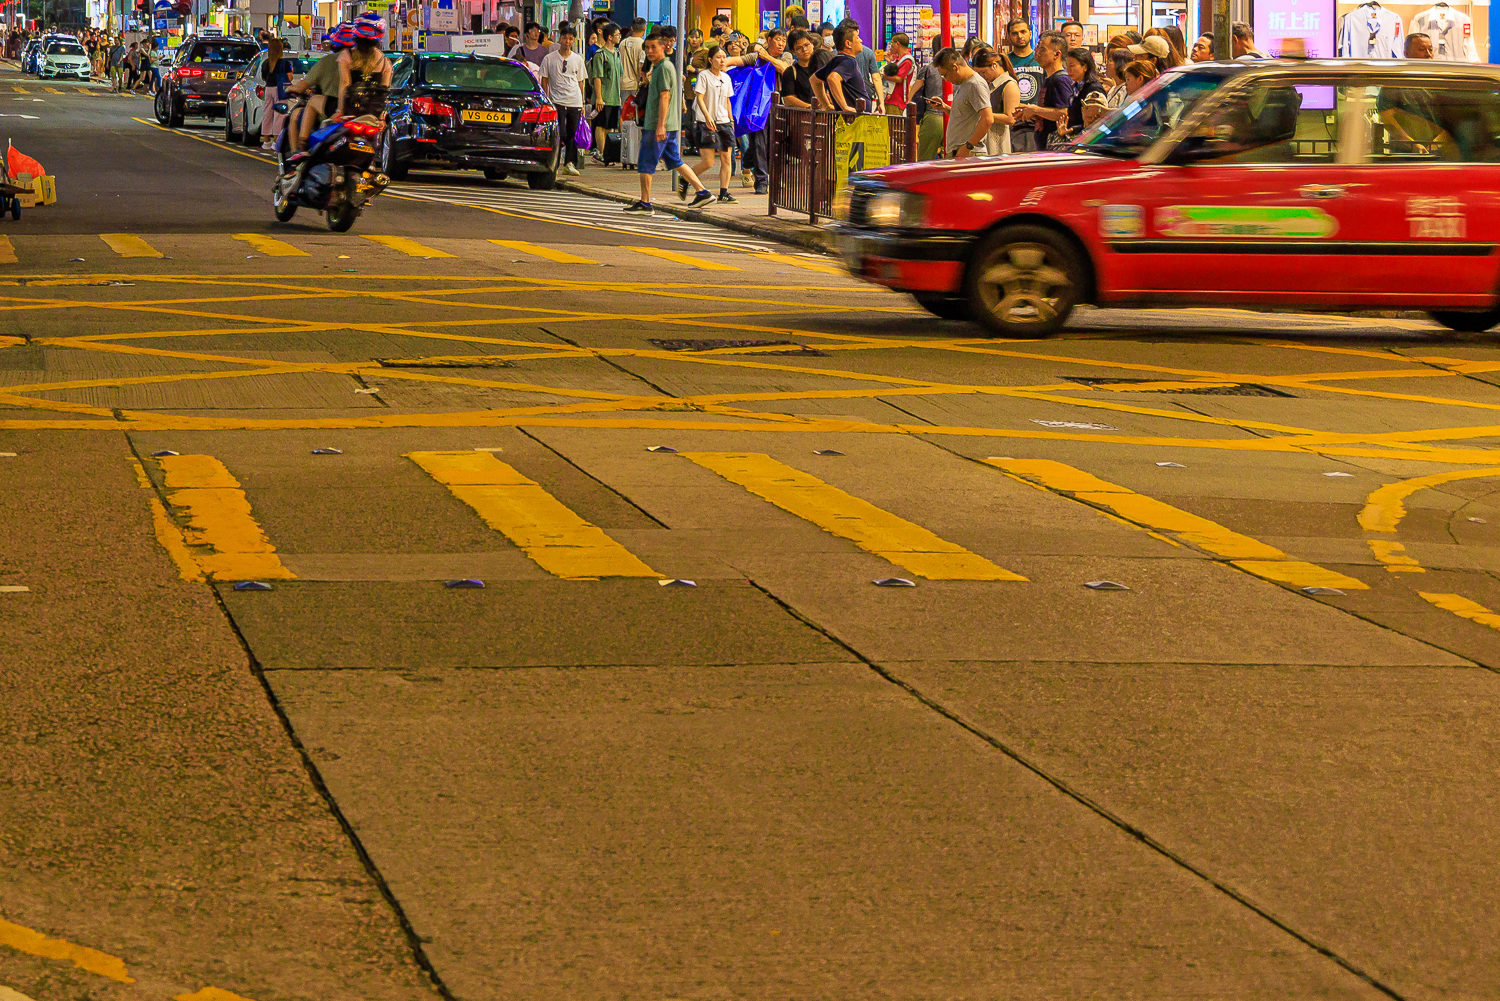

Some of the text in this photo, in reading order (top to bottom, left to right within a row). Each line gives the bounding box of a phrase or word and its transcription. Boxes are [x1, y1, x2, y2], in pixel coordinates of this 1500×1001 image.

[1268, 11, 1321, 30] 折上折
[468, 112, 506, 122] VS 664
